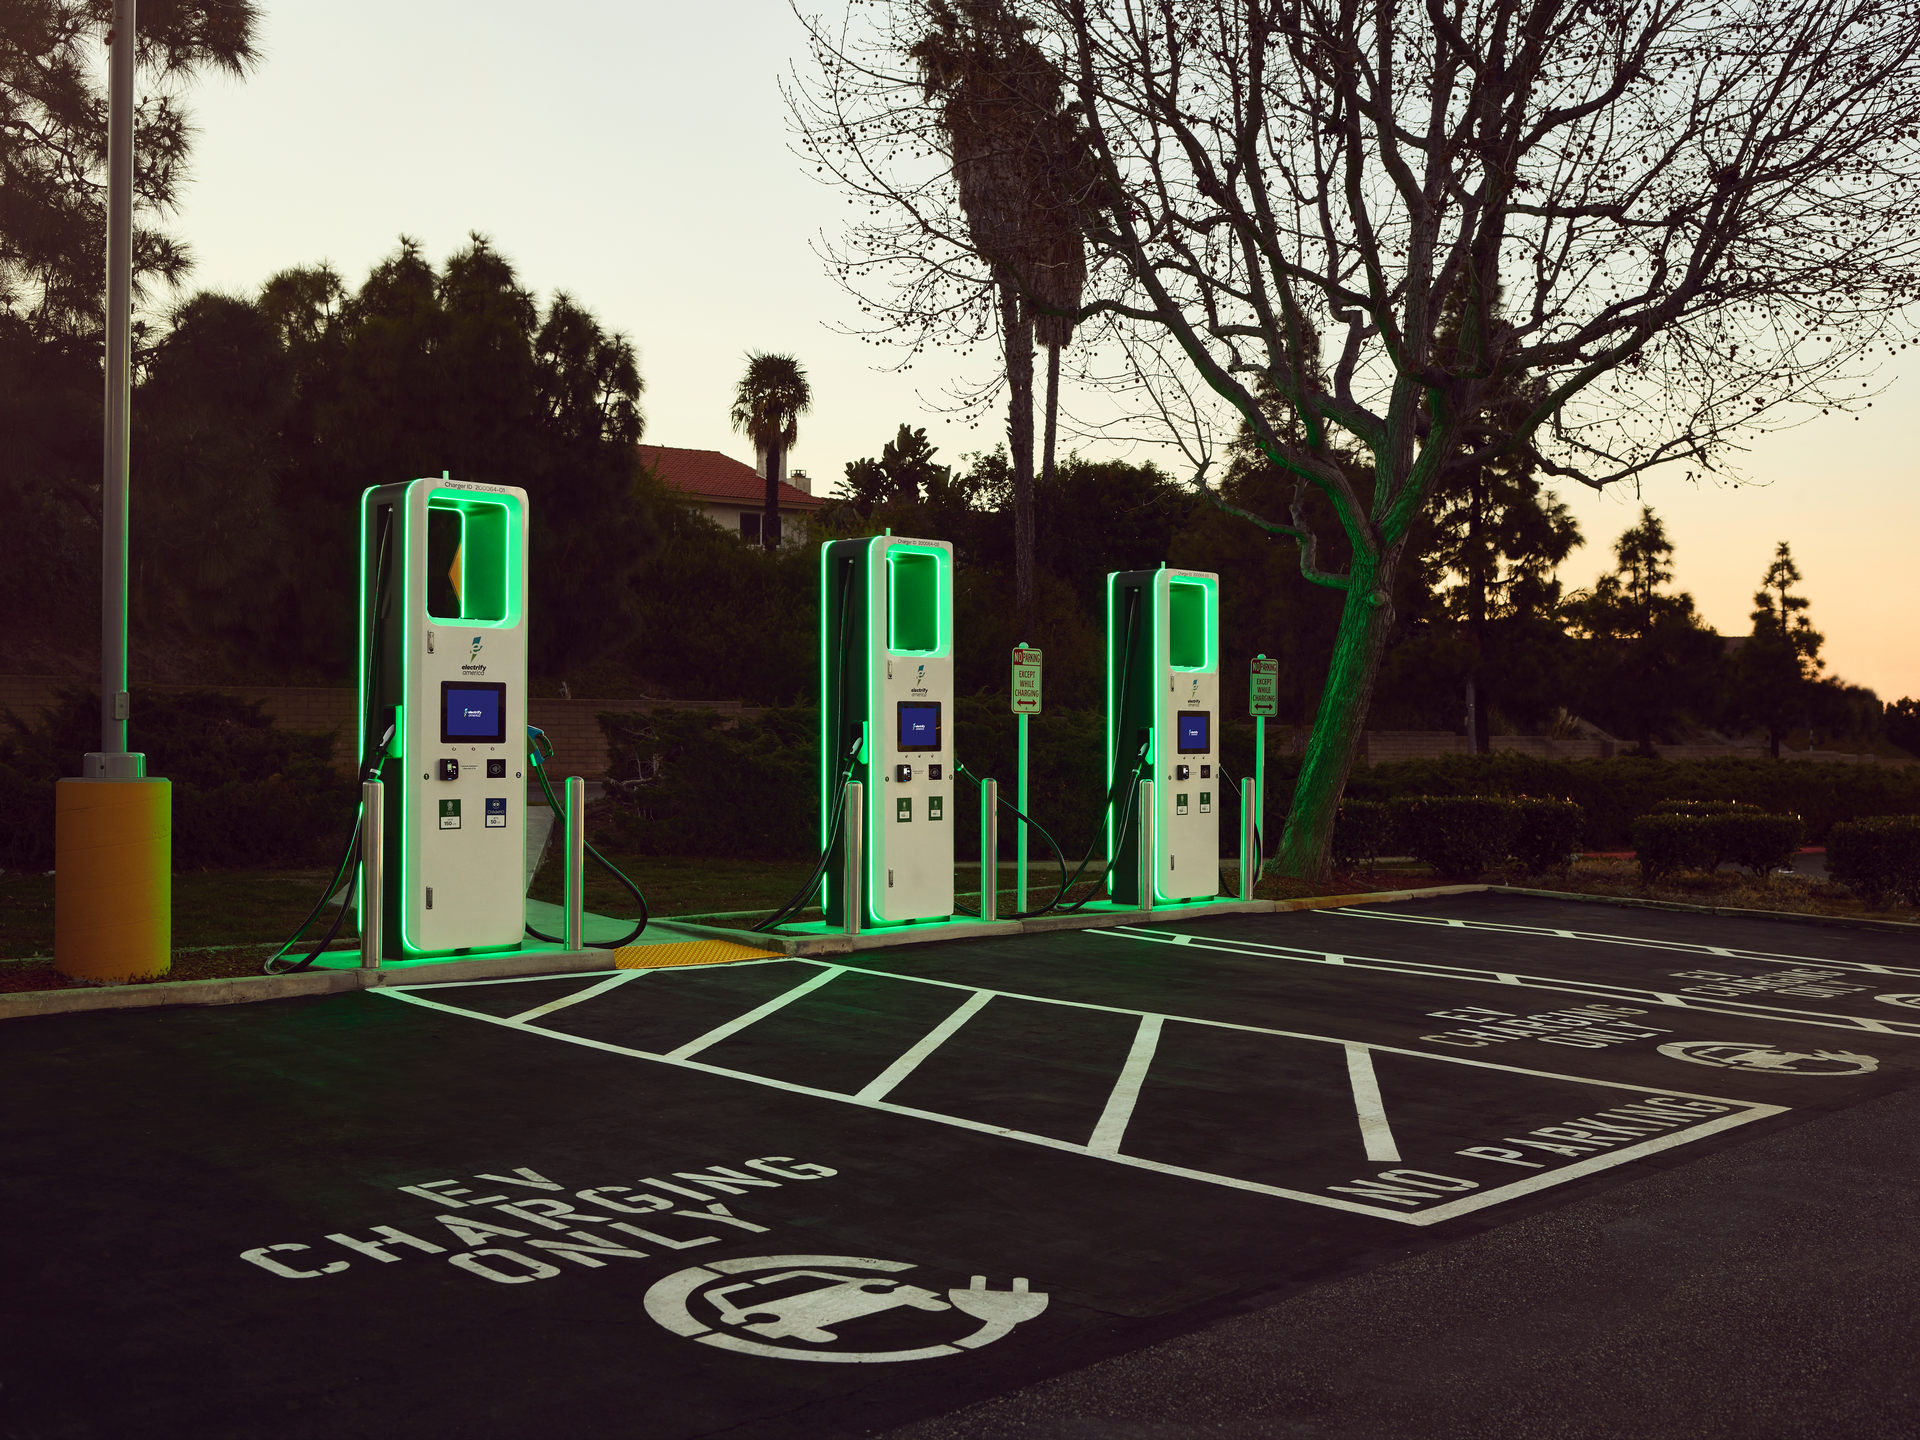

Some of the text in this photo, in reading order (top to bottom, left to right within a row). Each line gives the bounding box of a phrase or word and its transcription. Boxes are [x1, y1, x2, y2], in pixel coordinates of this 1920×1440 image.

[444, 482, 466, 490] Charger
[1014, 652, 1040, 663] NO PARKING
[1019, 670, 1035, 678] EXCEPT
[1020, 680, 1034, 688] WHILE
[1015, 689, 1039, 698] CHARGING
[1253, 694, 1275, 702] CHARGING
[1668, 969, 1743, 981] EV
[1680, 968, 1846, 997] CHARGING
[1774, 979, 1878, 998] ONLY
[1425, 1006, 1517, 1023] EV
[1418, 1004, 1649, 1048] CHARGING
[1537, 1021, 1674, 1049] ONLY
[1326, 1097, 1731, 1206] NO PARKING
[398, 1167, 566, 1209] EV
[239, 1156, 838, 1279] CHARGING
[448, 1203, 772, 1284] ONLY
